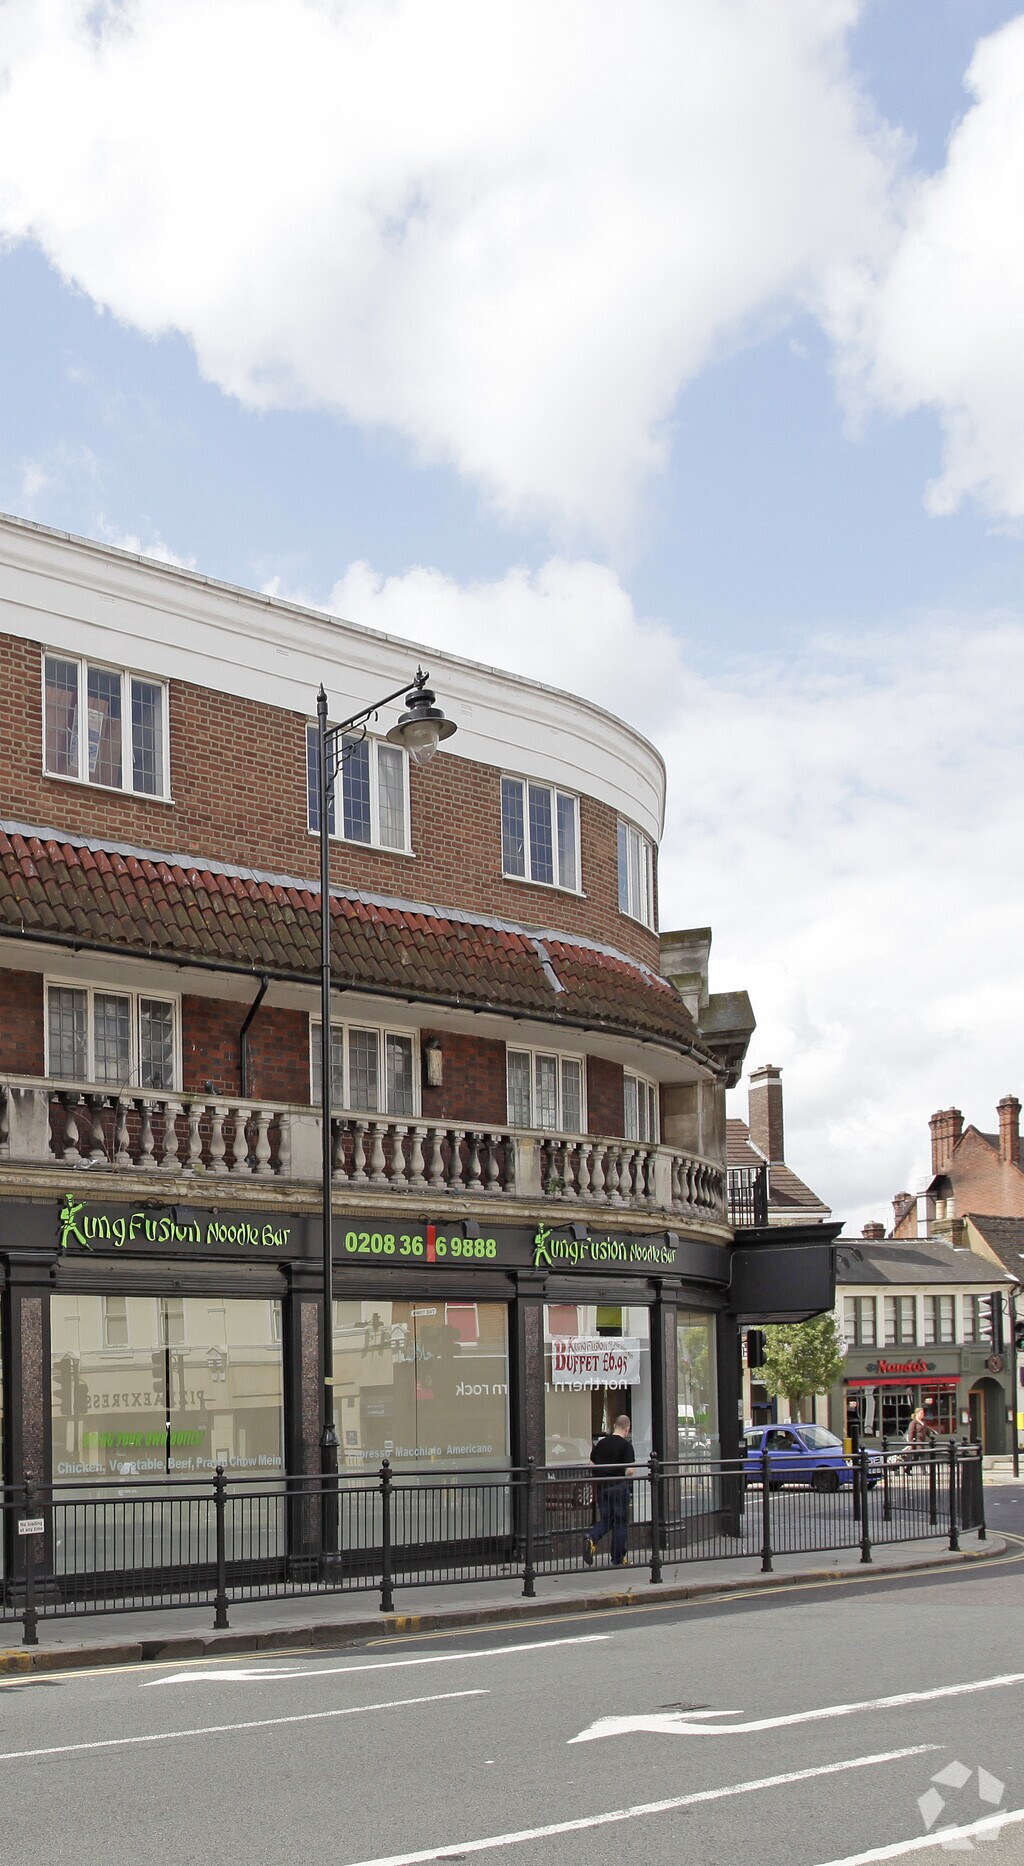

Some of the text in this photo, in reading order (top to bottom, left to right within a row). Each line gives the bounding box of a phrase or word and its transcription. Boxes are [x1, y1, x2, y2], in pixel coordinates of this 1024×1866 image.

[345, 1232, 395, 1254] 0208
[451, 1237, 497, 1258] 9888
[877, 1358, 928, 1374] Nando's
[395, 1446, 442, 1457] Macchiato
[446, 1444, 493, 1455] Americano
[229, 1456, 257, 1467] Chow
[258, 1454, 282, 1466] Mein
